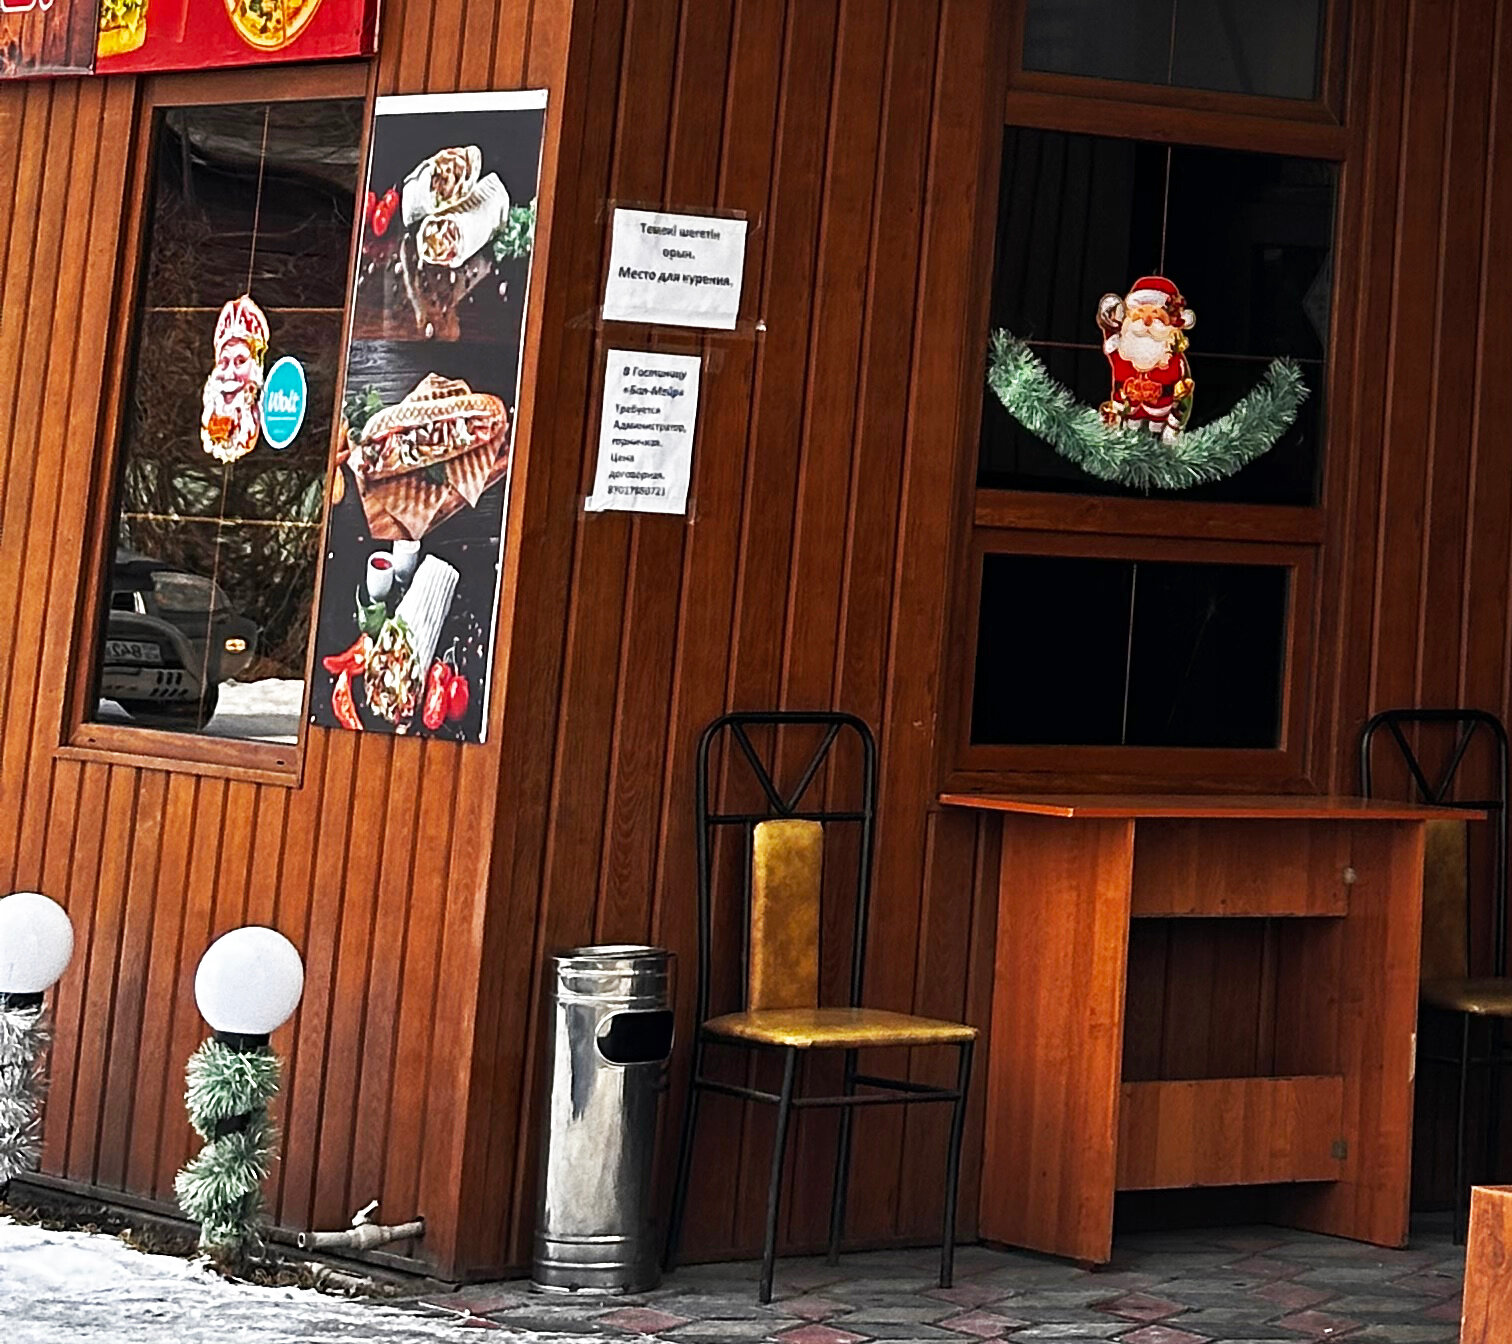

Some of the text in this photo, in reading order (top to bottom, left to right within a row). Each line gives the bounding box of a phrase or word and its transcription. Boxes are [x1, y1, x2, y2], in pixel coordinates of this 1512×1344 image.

[618, 266, 656, 280] Место
[658, 272, 680, 284] для
[267, 390, 300, 414] Wolt
